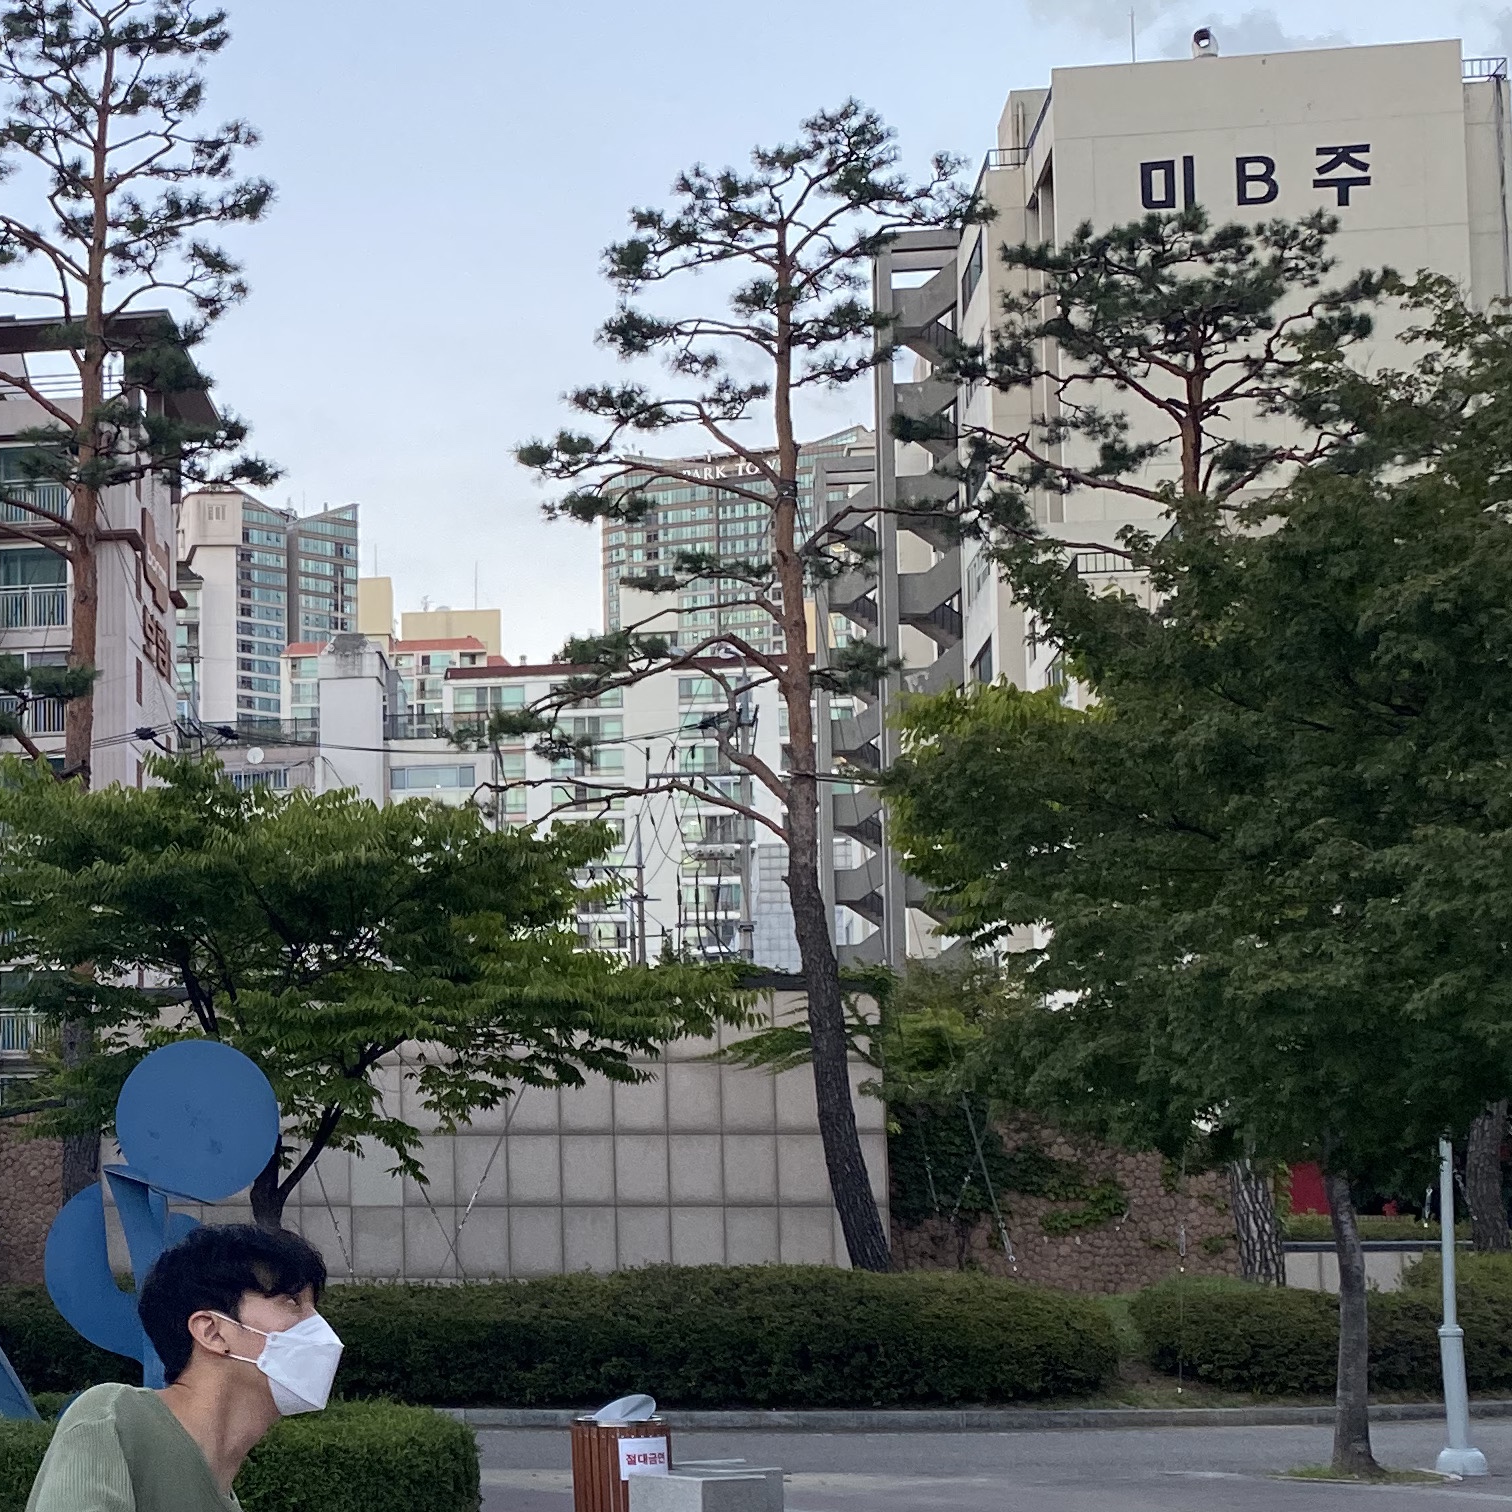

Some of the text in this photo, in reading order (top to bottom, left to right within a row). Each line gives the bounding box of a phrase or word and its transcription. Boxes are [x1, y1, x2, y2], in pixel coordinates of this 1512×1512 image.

[1140, 144, 1371, 210] 미 B 주
